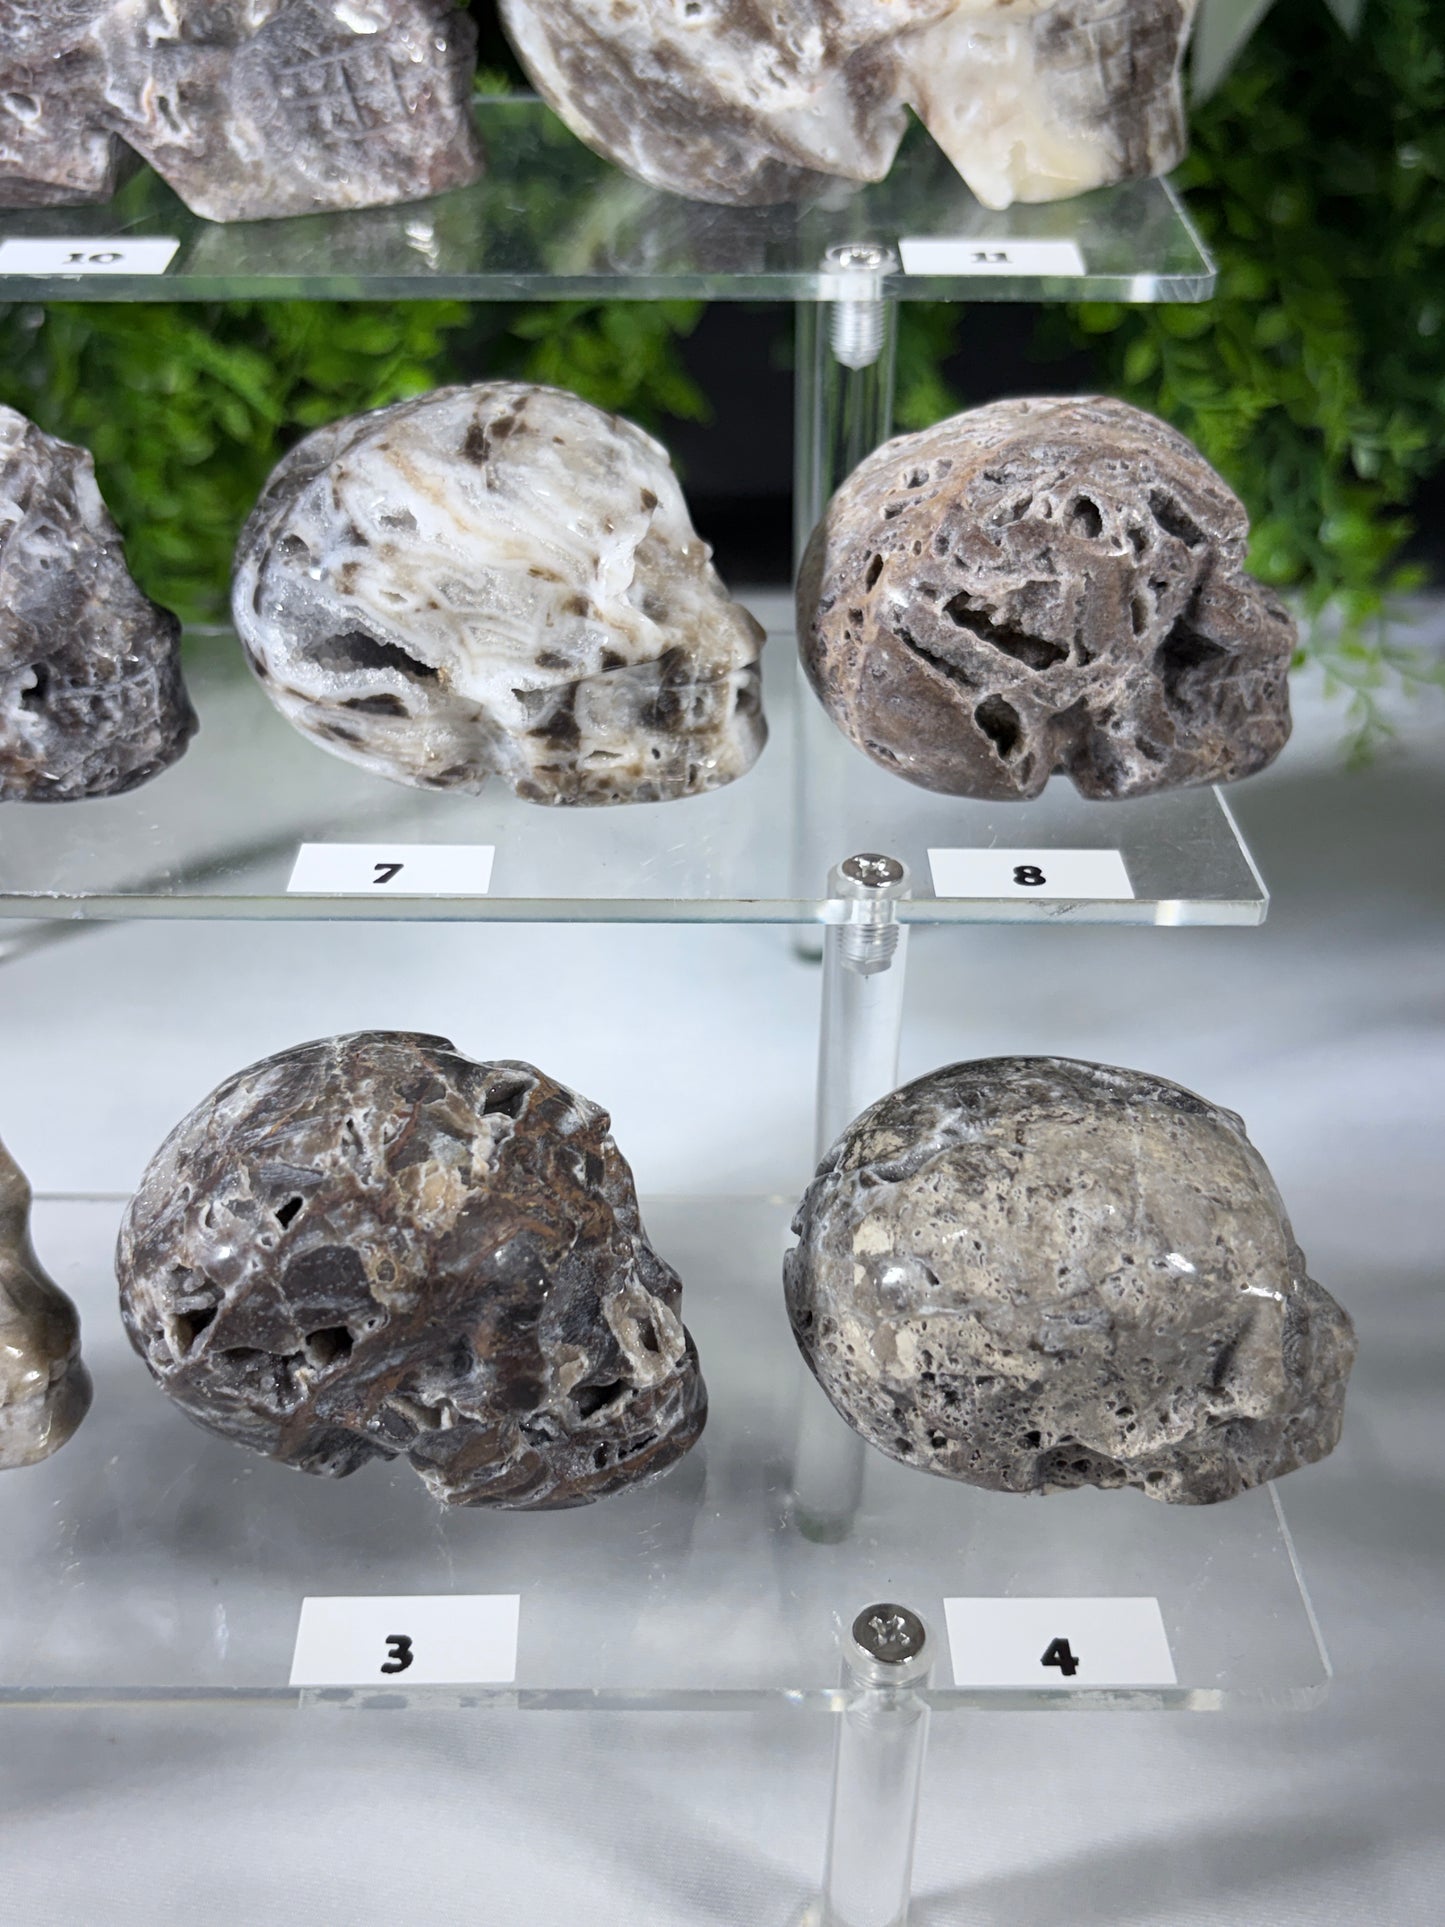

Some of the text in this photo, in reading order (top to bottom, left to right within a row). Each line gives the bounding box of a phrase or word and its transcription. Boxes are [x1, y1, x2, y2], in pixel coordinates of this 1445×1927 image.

[62, 252, 125, 264] 10
[971, 252, 1013, 263] 11
[372, 863, 404, 884] 7
[1013, 865, 1047, 887] 8
[380, 1634, 414, 1674] 3
[1040, 1637, 1079, 1676] 4
